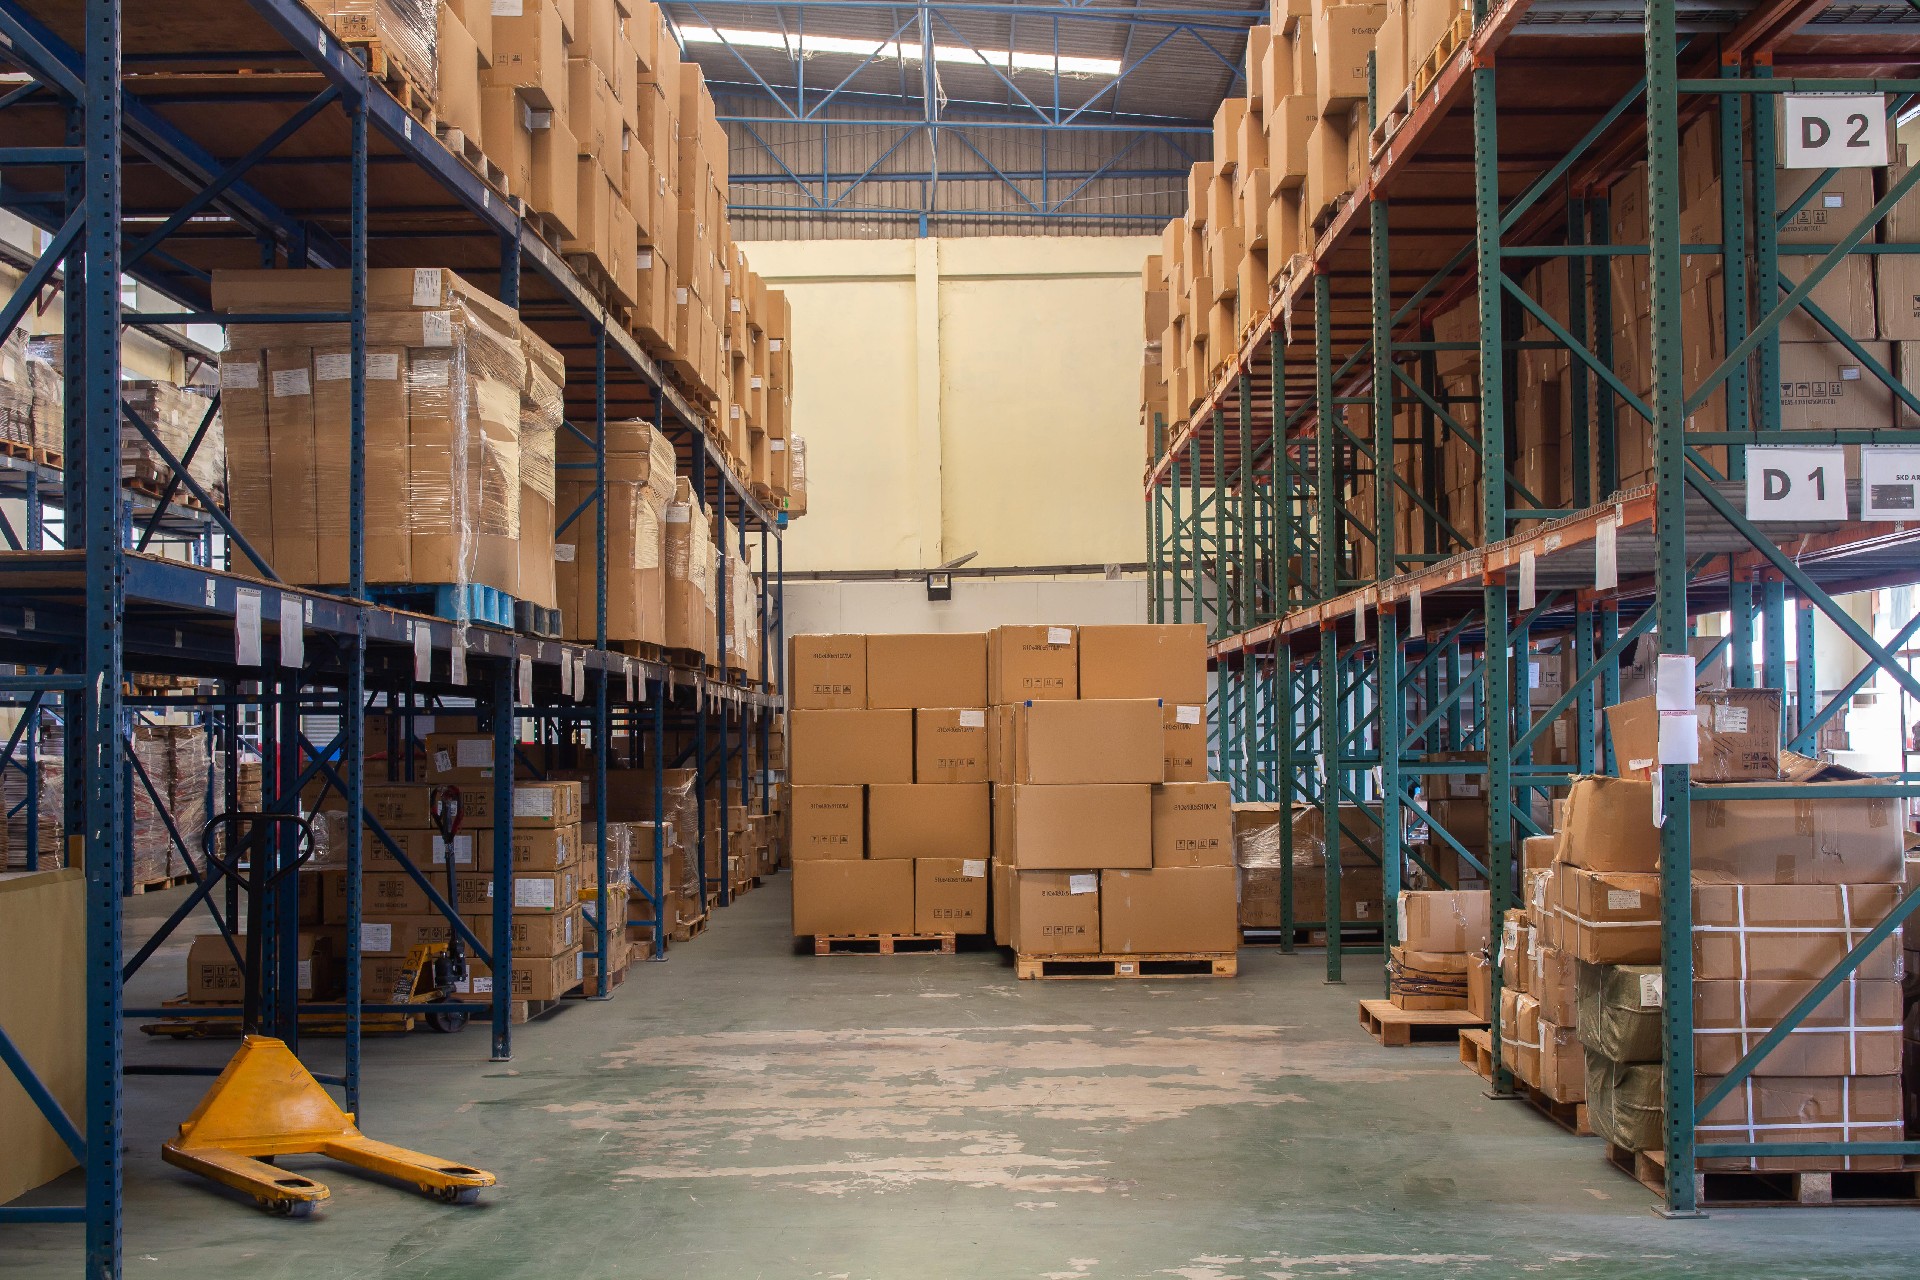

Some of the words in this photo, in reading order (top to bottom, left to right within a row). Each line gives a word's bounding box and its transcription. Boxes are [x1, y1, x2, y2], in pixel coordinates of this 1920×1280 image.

[1802, 117, 1830, 148] D
[1846, 113, 1870, 147] 2
[1763, 469, 1791, 500] D
[1808, 467, 1824, 500] 1
